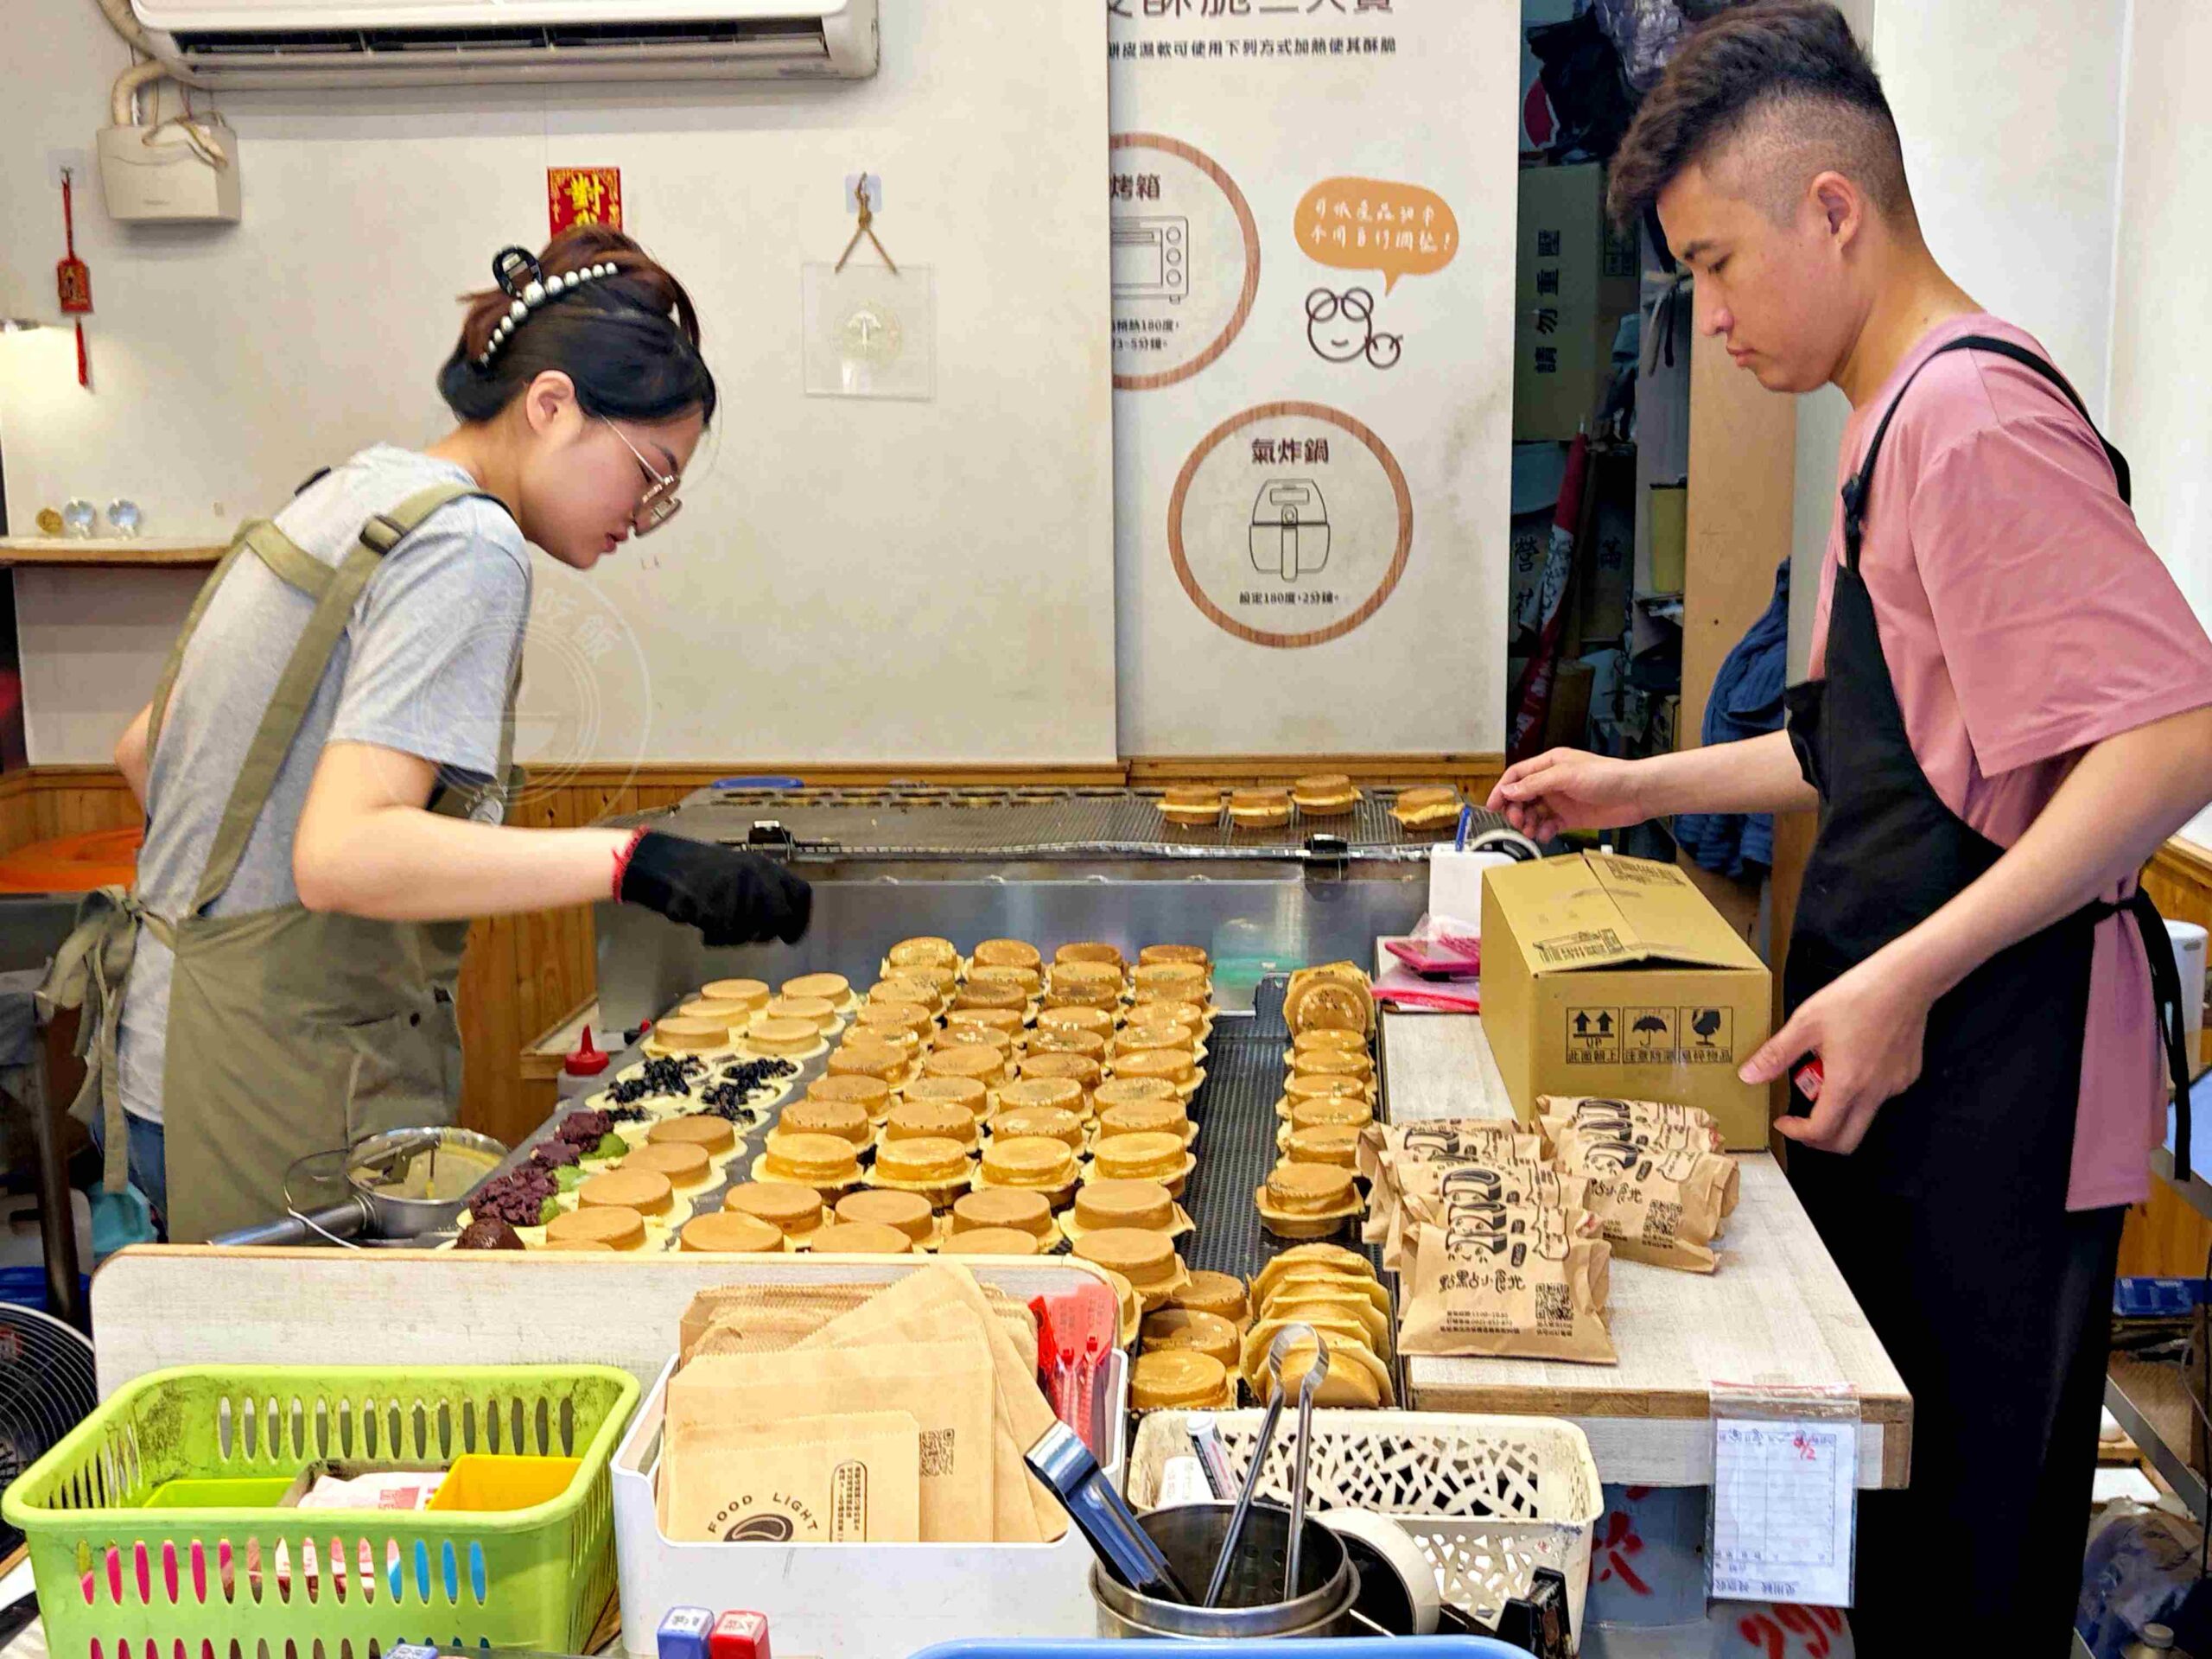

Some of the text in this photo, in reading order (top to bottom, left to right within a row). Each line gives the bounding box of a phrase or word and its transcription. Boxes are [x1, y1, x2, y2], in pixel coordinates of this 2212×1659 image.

[1252, 437, 1329, 464] 氣炸鍋
[708, 1495, 753, 1534] FOOD
[772, 1491, 818, 1532] LIGHT
